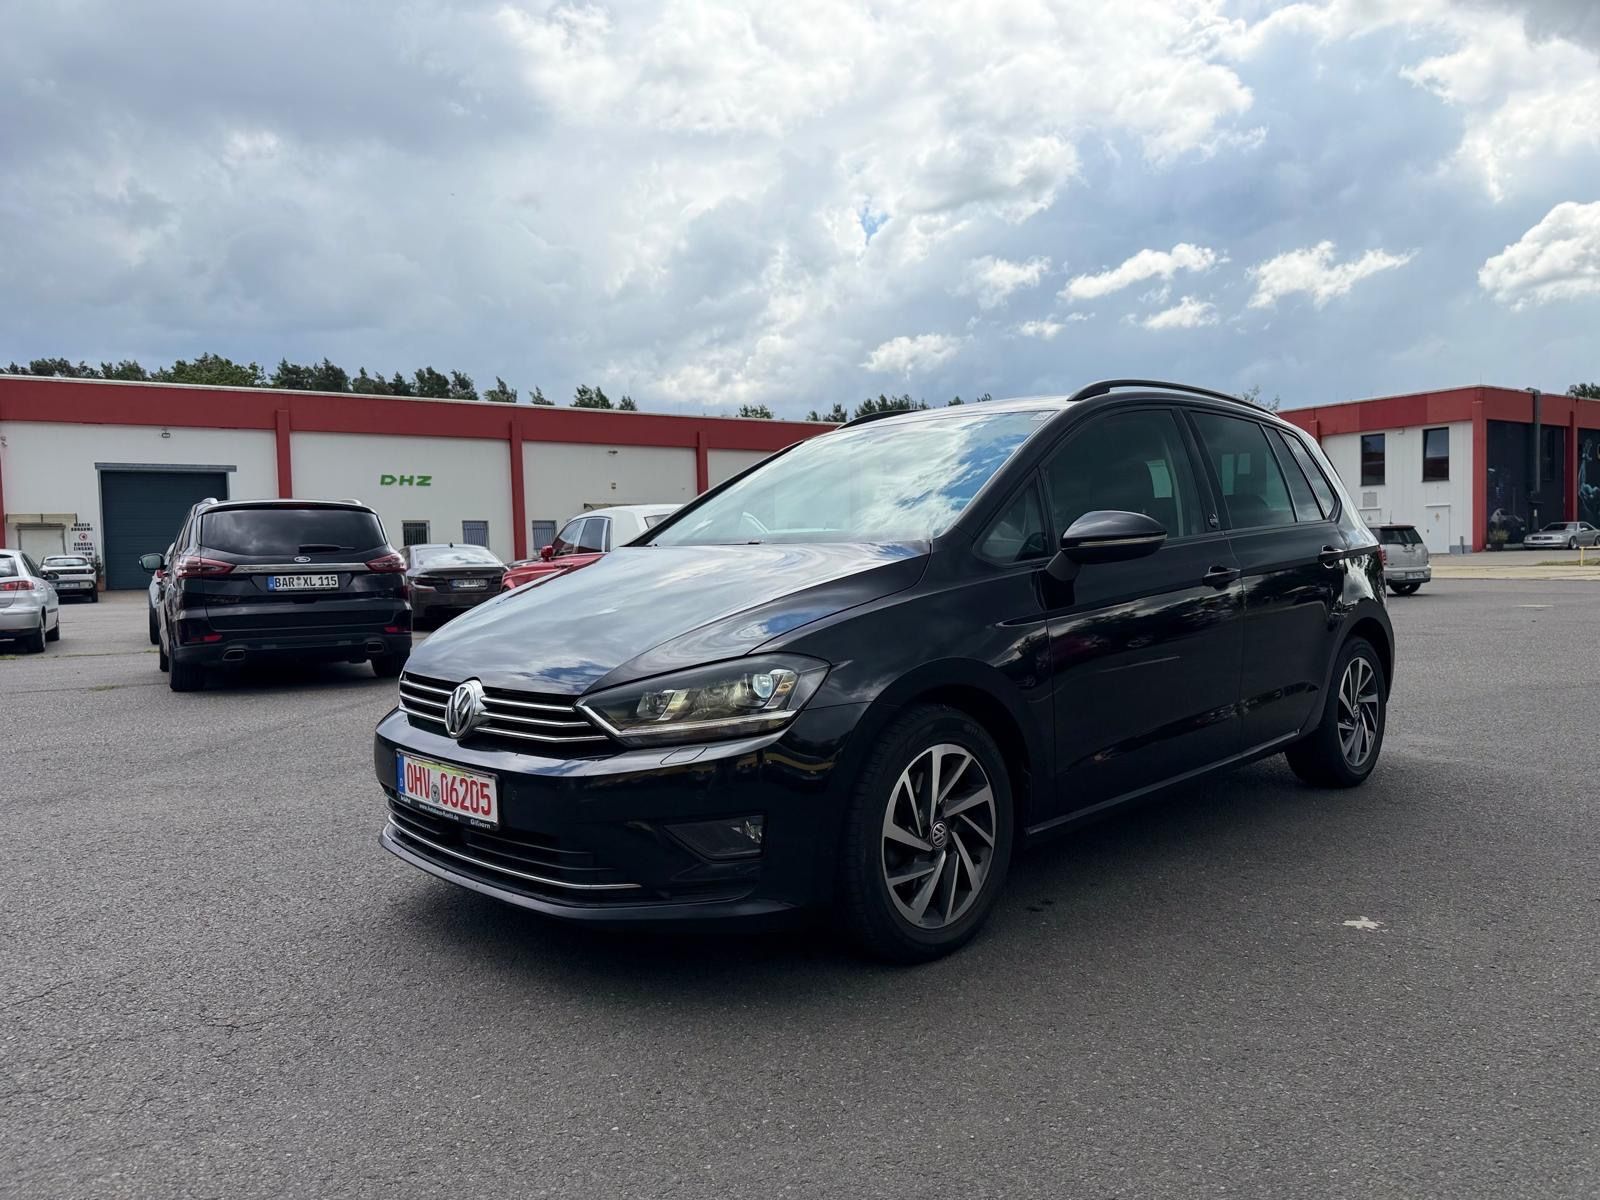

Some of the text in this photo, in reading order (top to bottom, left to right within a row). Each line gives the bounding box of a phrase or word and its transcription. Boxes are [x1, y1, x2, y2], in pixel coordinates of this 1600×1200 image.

[380, 474, 432, 486] DHZ
[274, 576, 337, 587] BAR XL 115
[407, 762, 491, 816] OHV 06205
